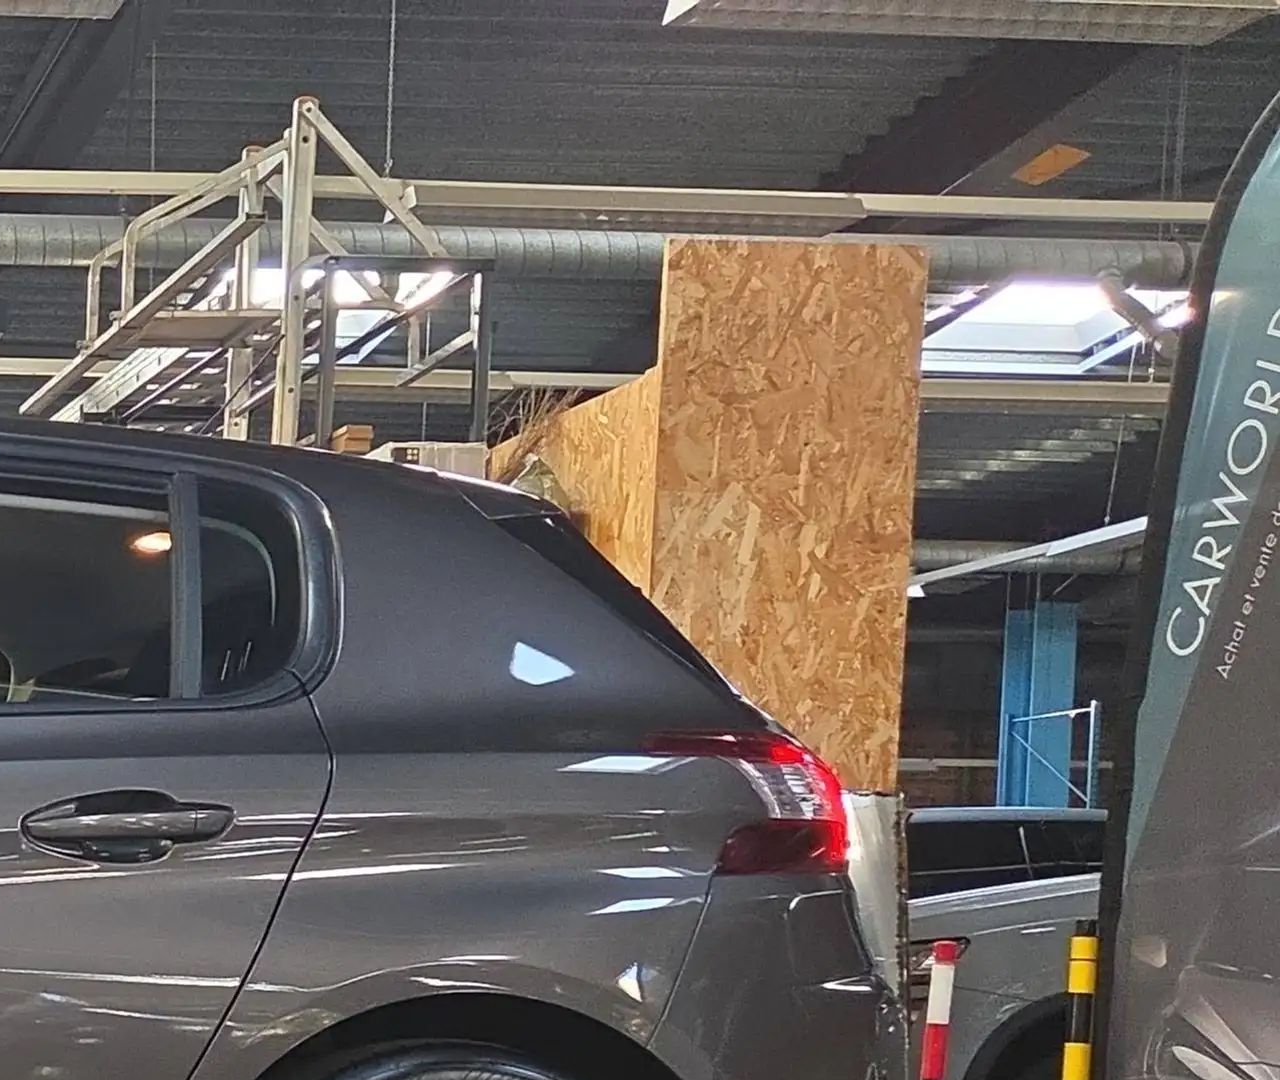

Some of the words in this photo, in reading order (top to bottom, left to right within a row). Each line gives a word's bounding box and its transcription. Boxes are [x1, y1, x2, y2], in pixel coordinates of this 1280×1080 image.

[1216, 621, 1246, 679] Achat
[1242, 594, 1256, 615] et
[1249, 533, 1278, 588] vente
